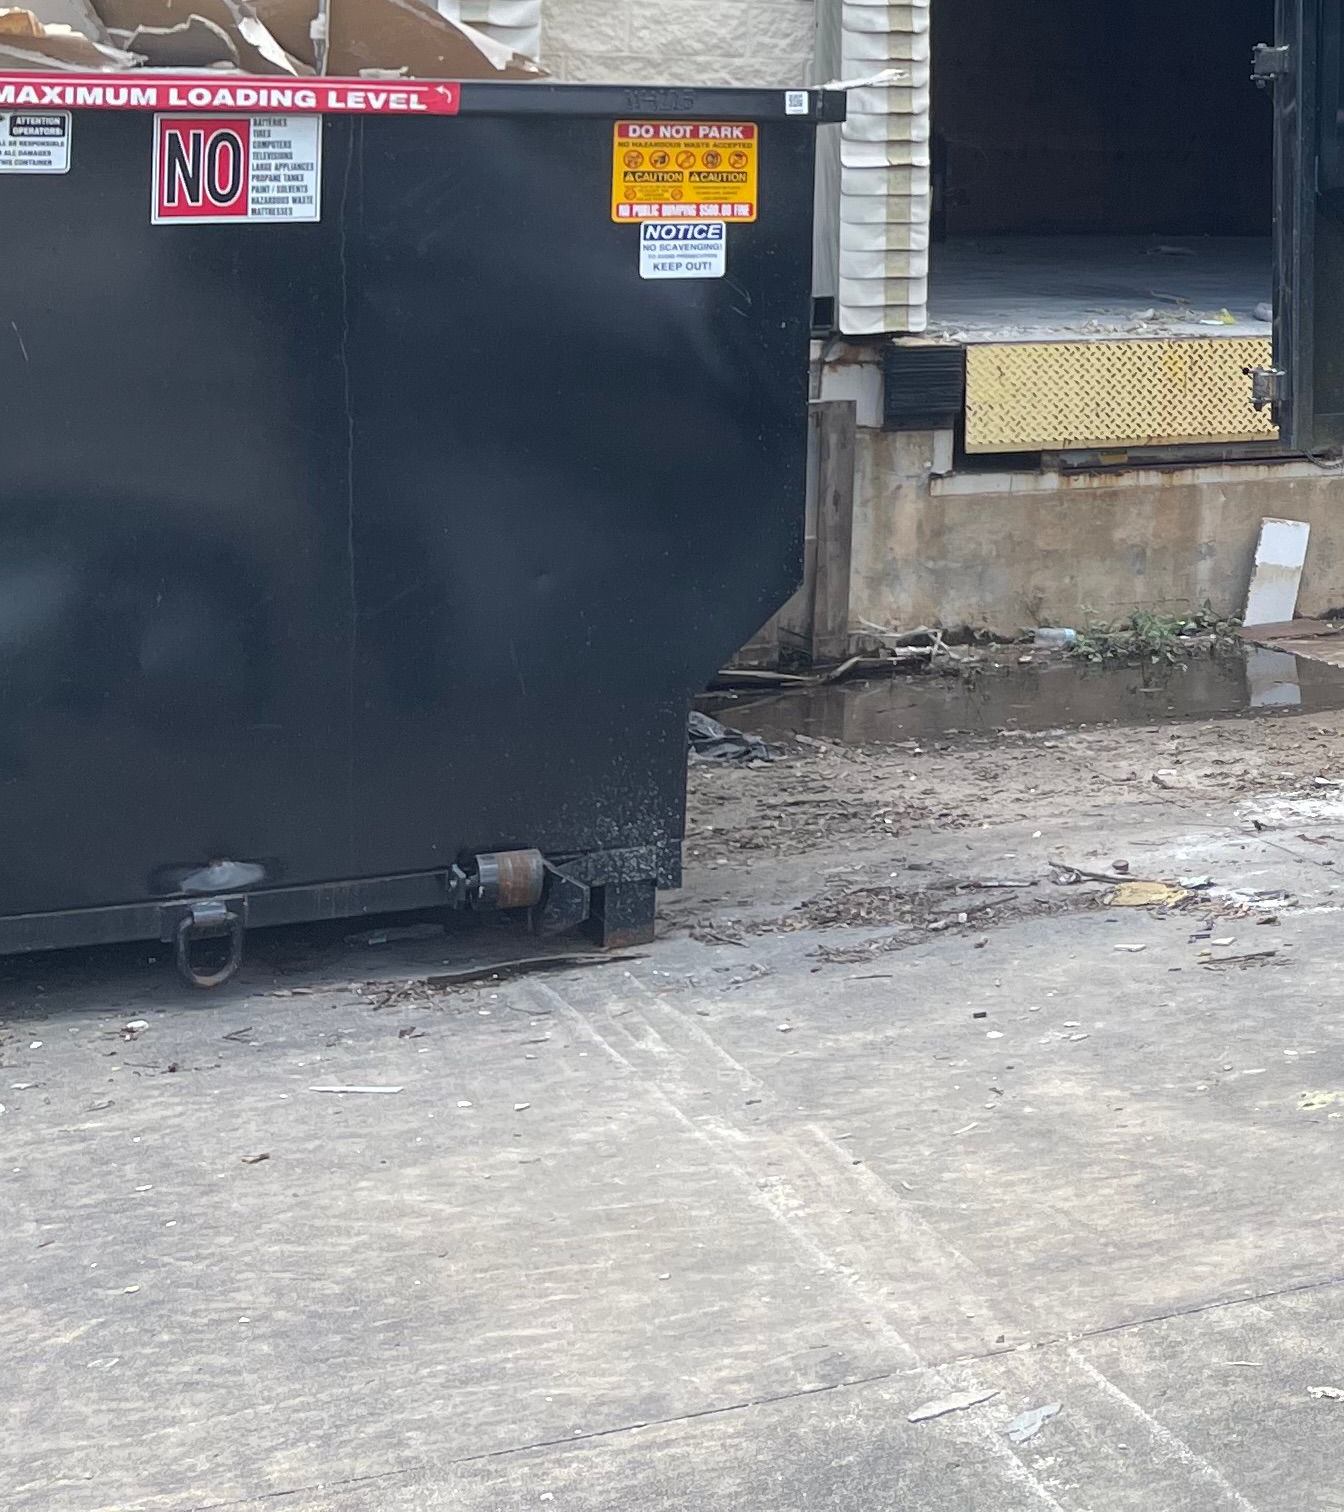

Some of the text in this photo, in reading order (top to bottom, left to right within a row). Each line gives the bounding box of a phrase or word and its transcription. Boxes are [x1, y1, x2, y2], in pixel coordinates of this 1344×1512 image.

[0, 85, 428, 110] MAXIMUM LOADING LEVEL
[16, 116, 60, 125] ATTENTION
[253, 118, 287, 127] BATTERIES
[253, 129, 271, 138] TIRES
[628, 125, 744, 139] DO NOT PARK
[253, 140, 292, 149] COMPUTERS
[253, 152, 293, 160] TELEVISIONS
[164, 128, 244, 207] NO
[252, 162, 314, 171] LARGE APPLIANCES
[252, 174, 304, 182] PROPANE TANKS
[634, 172, 683, 182] CAUTION
[700, 172, 747, 182] CAUTION
[252, 185, 270, 193] PAINT
[251, 196, 313, 204] HAZARDOUS WASTE
[251, 207, 293, 216] MATTRESSES
[645, 224, 722, 239] NOTICE
[642, 243, 722, 251] NO SCAVENGING!
[653, 261, 712, 271] KEEP OUT!
